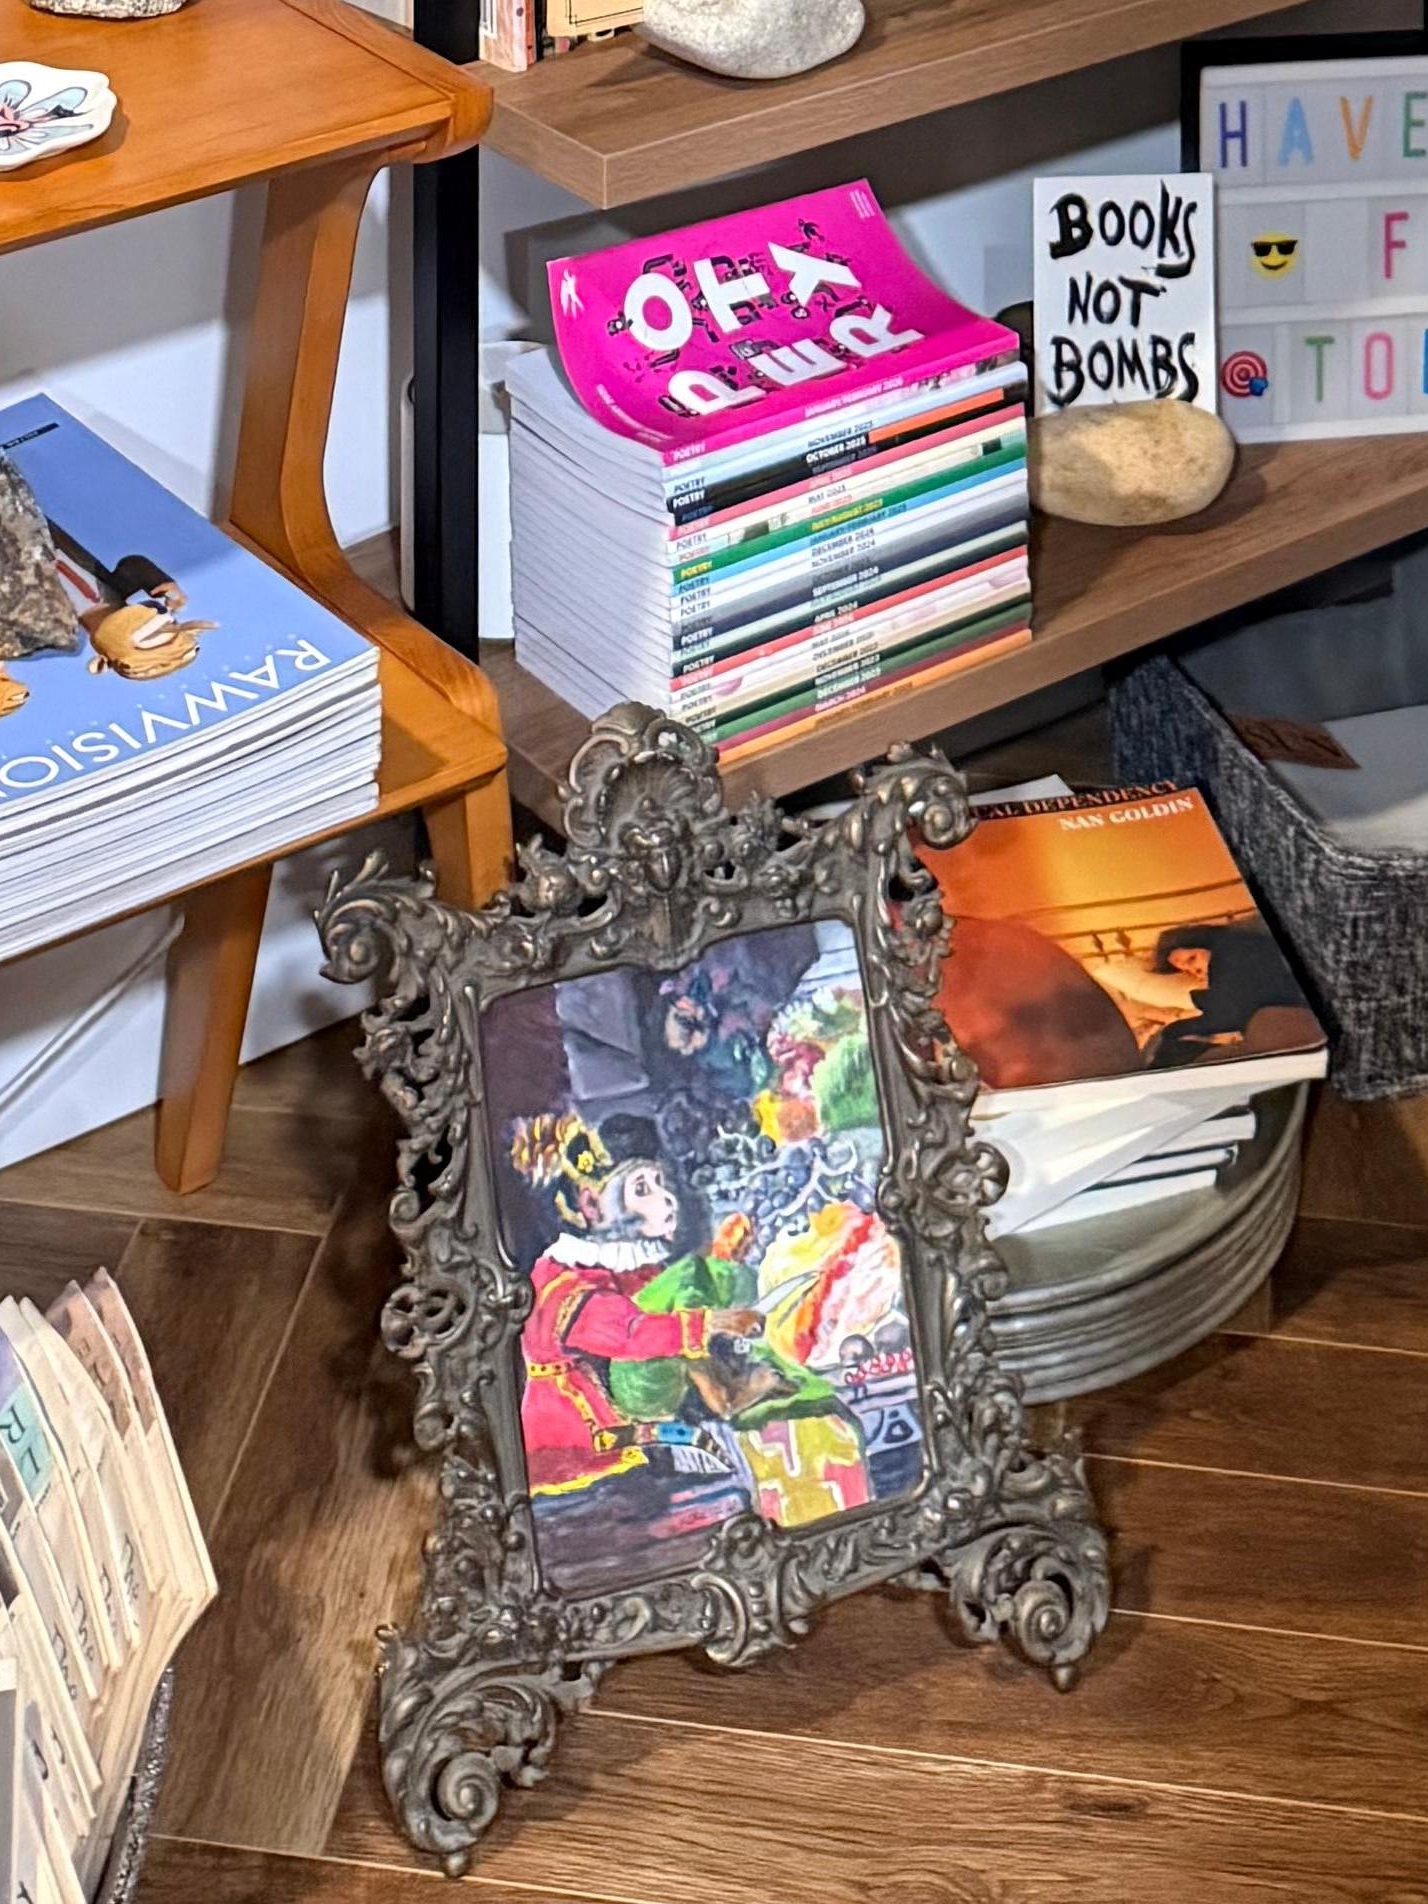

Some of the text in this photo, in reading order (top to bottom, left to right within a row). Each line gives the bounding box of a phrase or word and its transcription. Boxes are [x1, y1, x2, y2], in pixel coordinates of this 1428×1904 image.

[1048, 180, 1199, 279] BOOKS
[1067, 270, 1167, 328] NOT
[1047, 332, 1199, 406] BOMBS
[673, 444, 706, 461] POETRY
[673, 440, 844, 508] POETRY OCTOBER
[674, 476, 706, 492] POETRY
[681, 561, 713, 578] POETRY
[679, 577, 710, 592] POETRY
[681, 627, 713, 645] POETRY
[683, 656, 714, 673] POETRY
[1024, 779, 1178, 814] DEPENDENCY
[1057, 796, 1194, 831] NAN GOLDIN
